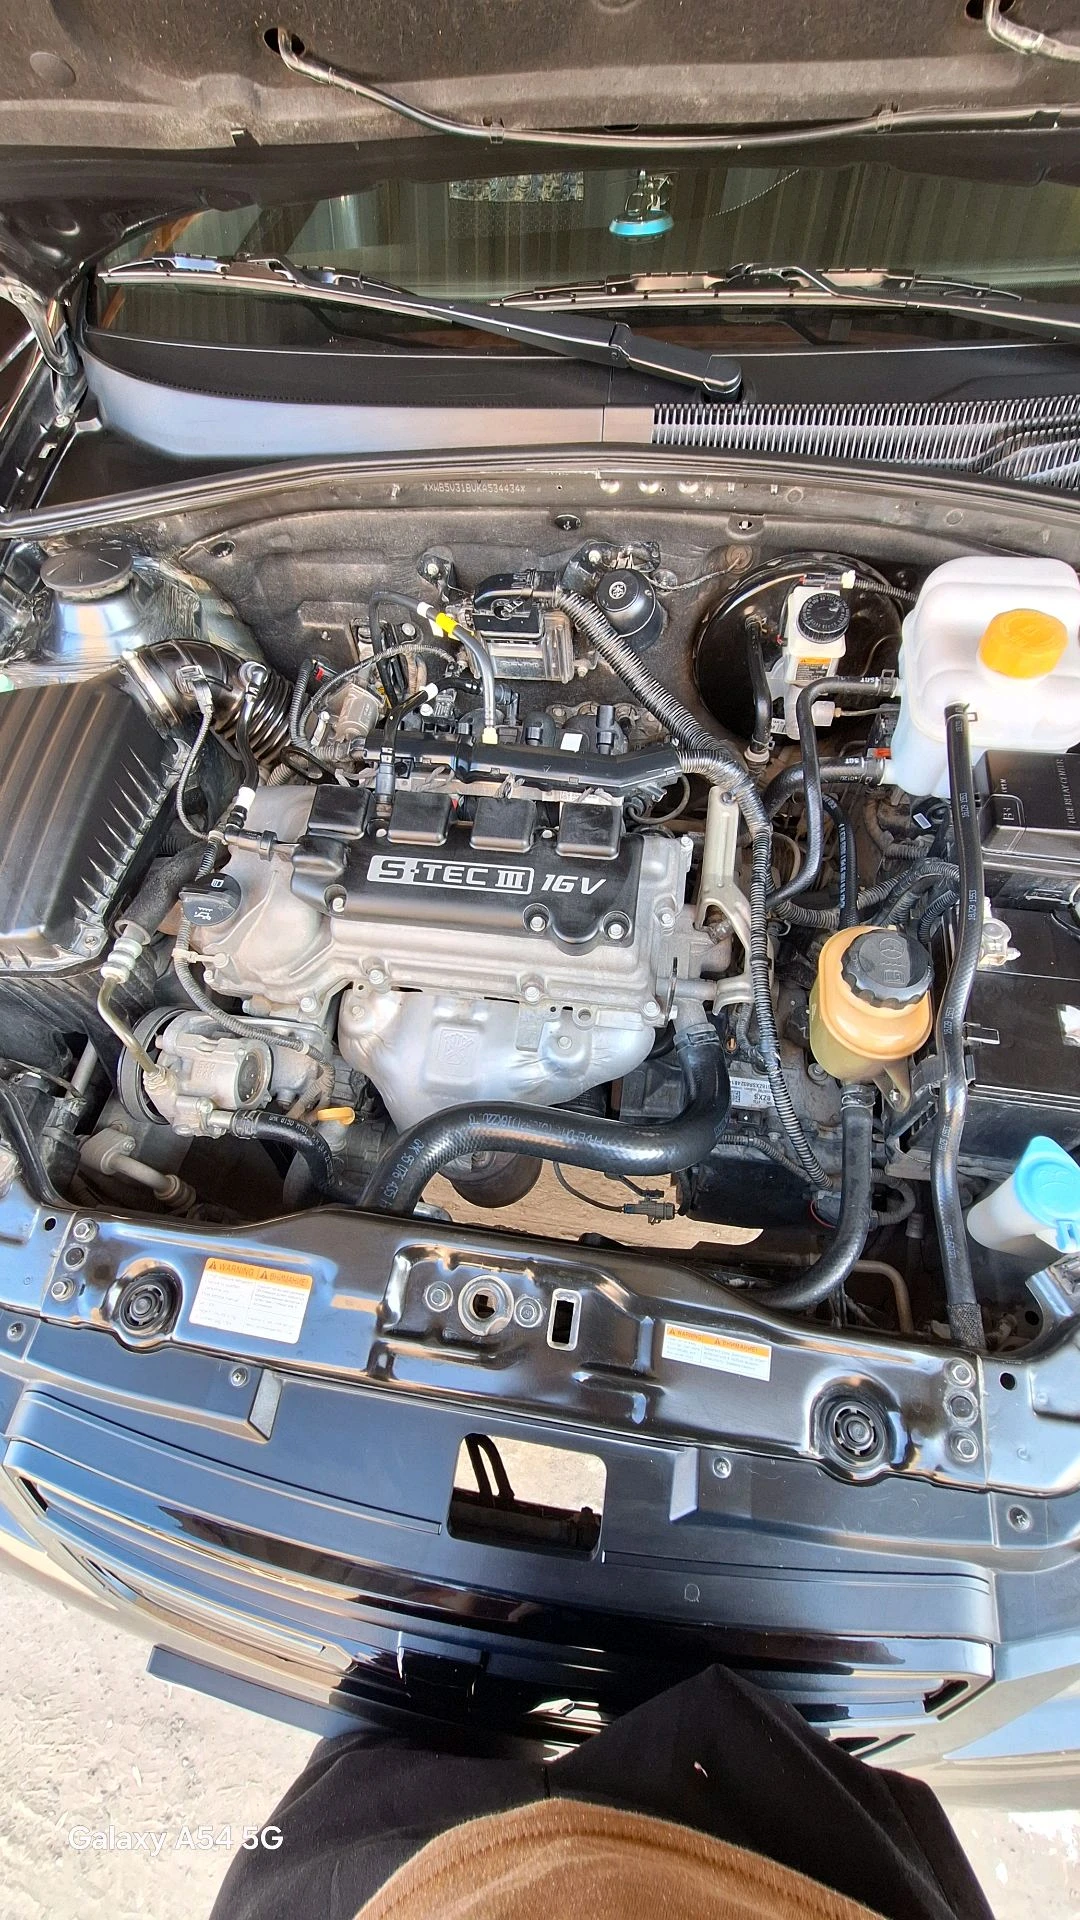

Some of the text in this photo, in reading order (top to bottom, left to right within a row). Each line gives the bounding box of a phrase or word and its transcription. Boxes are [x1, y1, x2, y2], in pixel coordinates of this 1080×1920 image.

[494, 869, 526, 890] III
[540, 873, 607, 895] 16V
[219, 1262, 255, 1277] WARNING
